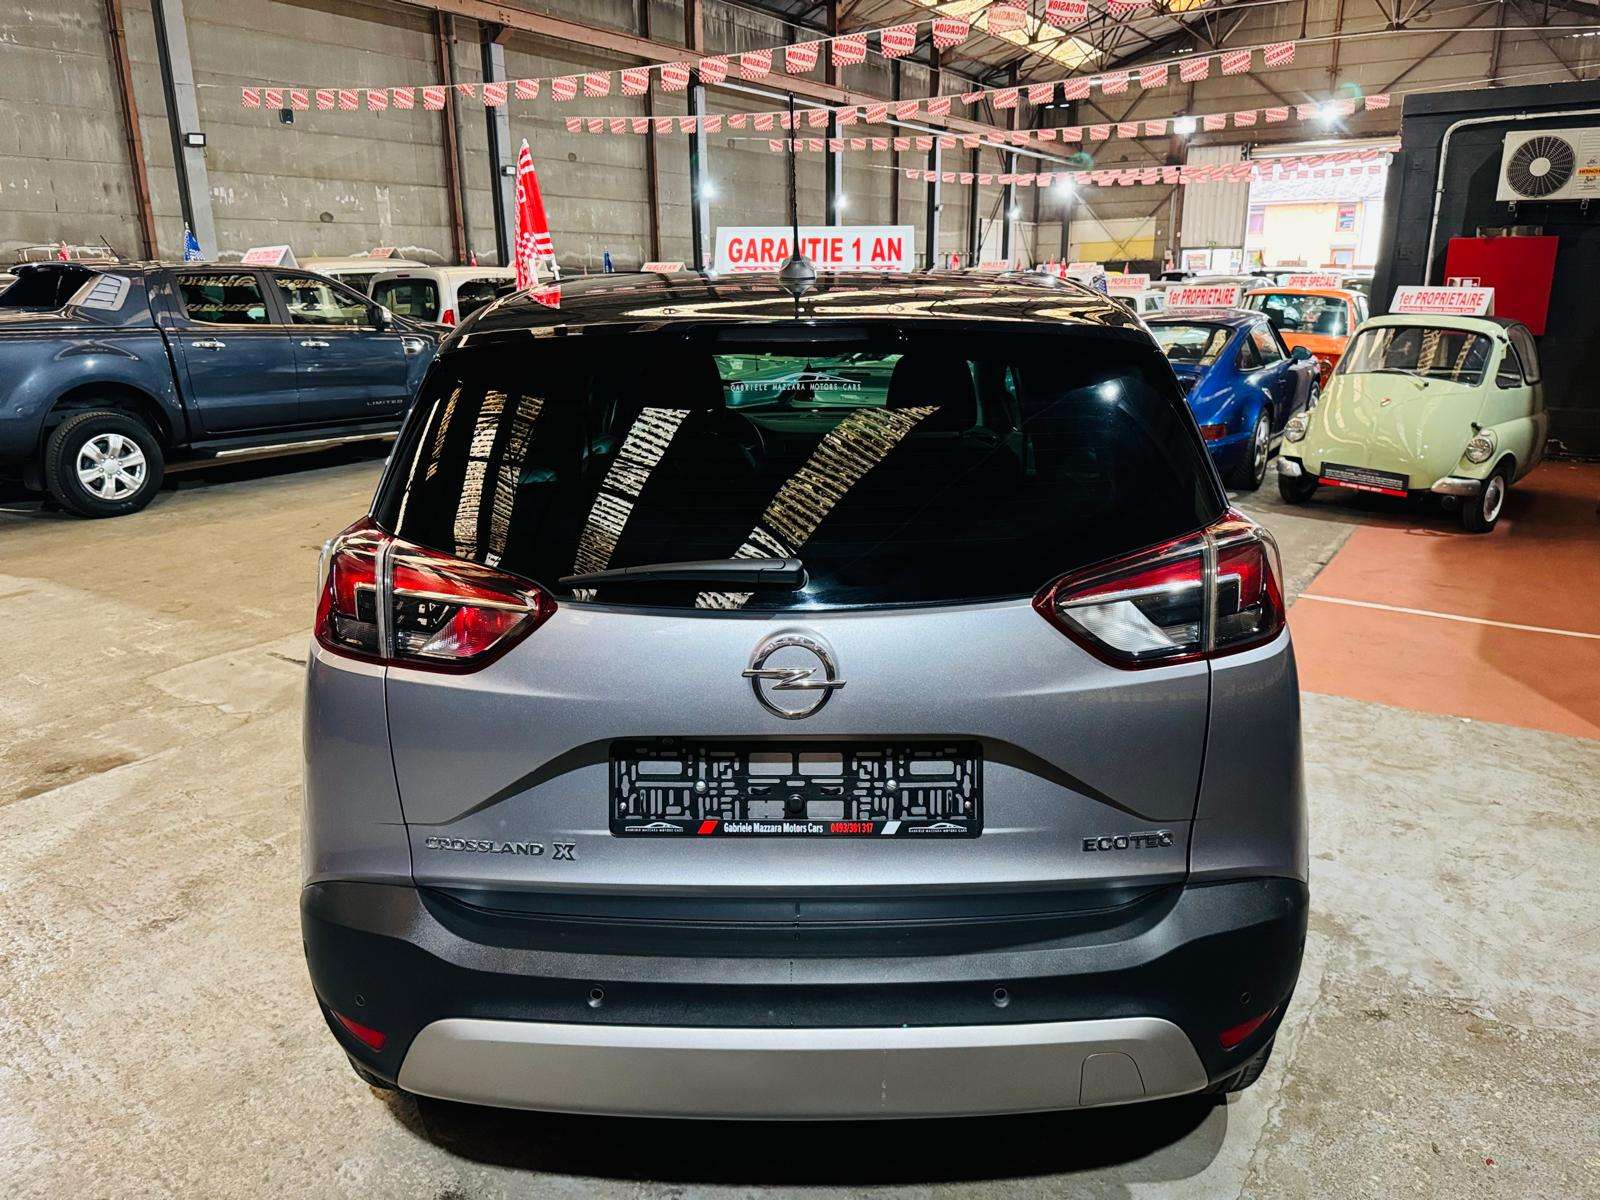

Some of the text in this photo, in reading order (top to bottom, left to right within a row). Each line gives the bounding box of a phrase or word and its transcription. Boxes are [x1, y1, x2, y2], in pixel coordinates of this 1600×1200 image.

[1221, 53, 1250, 70] OCCASION
[1264, 45, 1294, 63] OCCASION
[852, 237, 861, 262] 1
[871, 237, 902, 262] AN
[1168, 287, 1236, 305] 1er PROPRIETAIRE
[1399, 292, 1485, 307] 1er PROPRIETAIRE
[730, 382, 863, 392] GABRIELE MAZZARA MOTORS CARS
[723, 822, 752, 833] Gabriele
[753, 822, 782, 833] Mazzara
[783, 822, 807, 833] Motors
[808, 822, 824, 833] Cars
[425, 836, 577, 861] CROSSLAND X
[1082, 830, 1175, 852] ECOTEC
